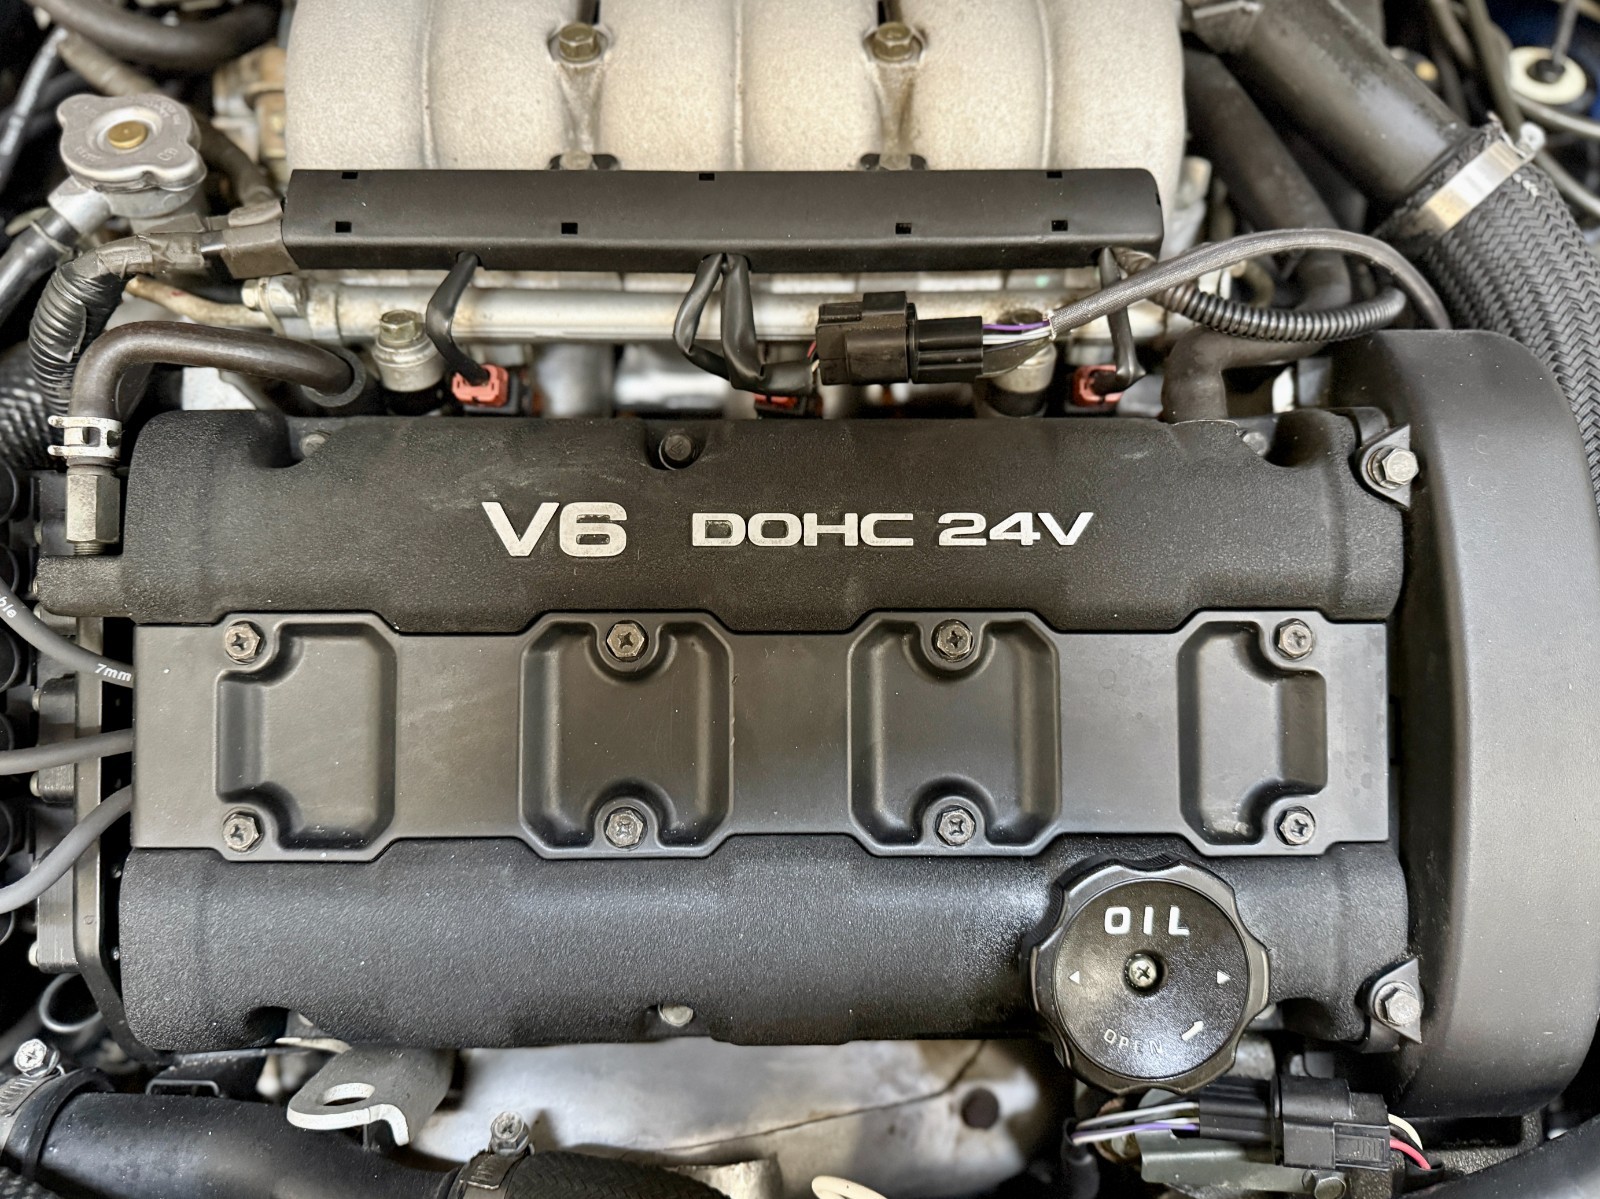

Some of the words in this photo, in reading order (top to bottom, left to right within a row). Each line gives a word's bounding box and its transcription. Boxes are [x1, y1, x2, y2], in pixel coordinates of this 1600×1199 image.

[481, 501, 628, 557] V6
[692, 512, 914, 547] DOHC
[937, 511, 1095, 546] 24V
[94, 663, 132, 682] 7mm
[1104, 905, 1190, 936] OIL
[1103, 1028, 1165, 1056] OPEN
